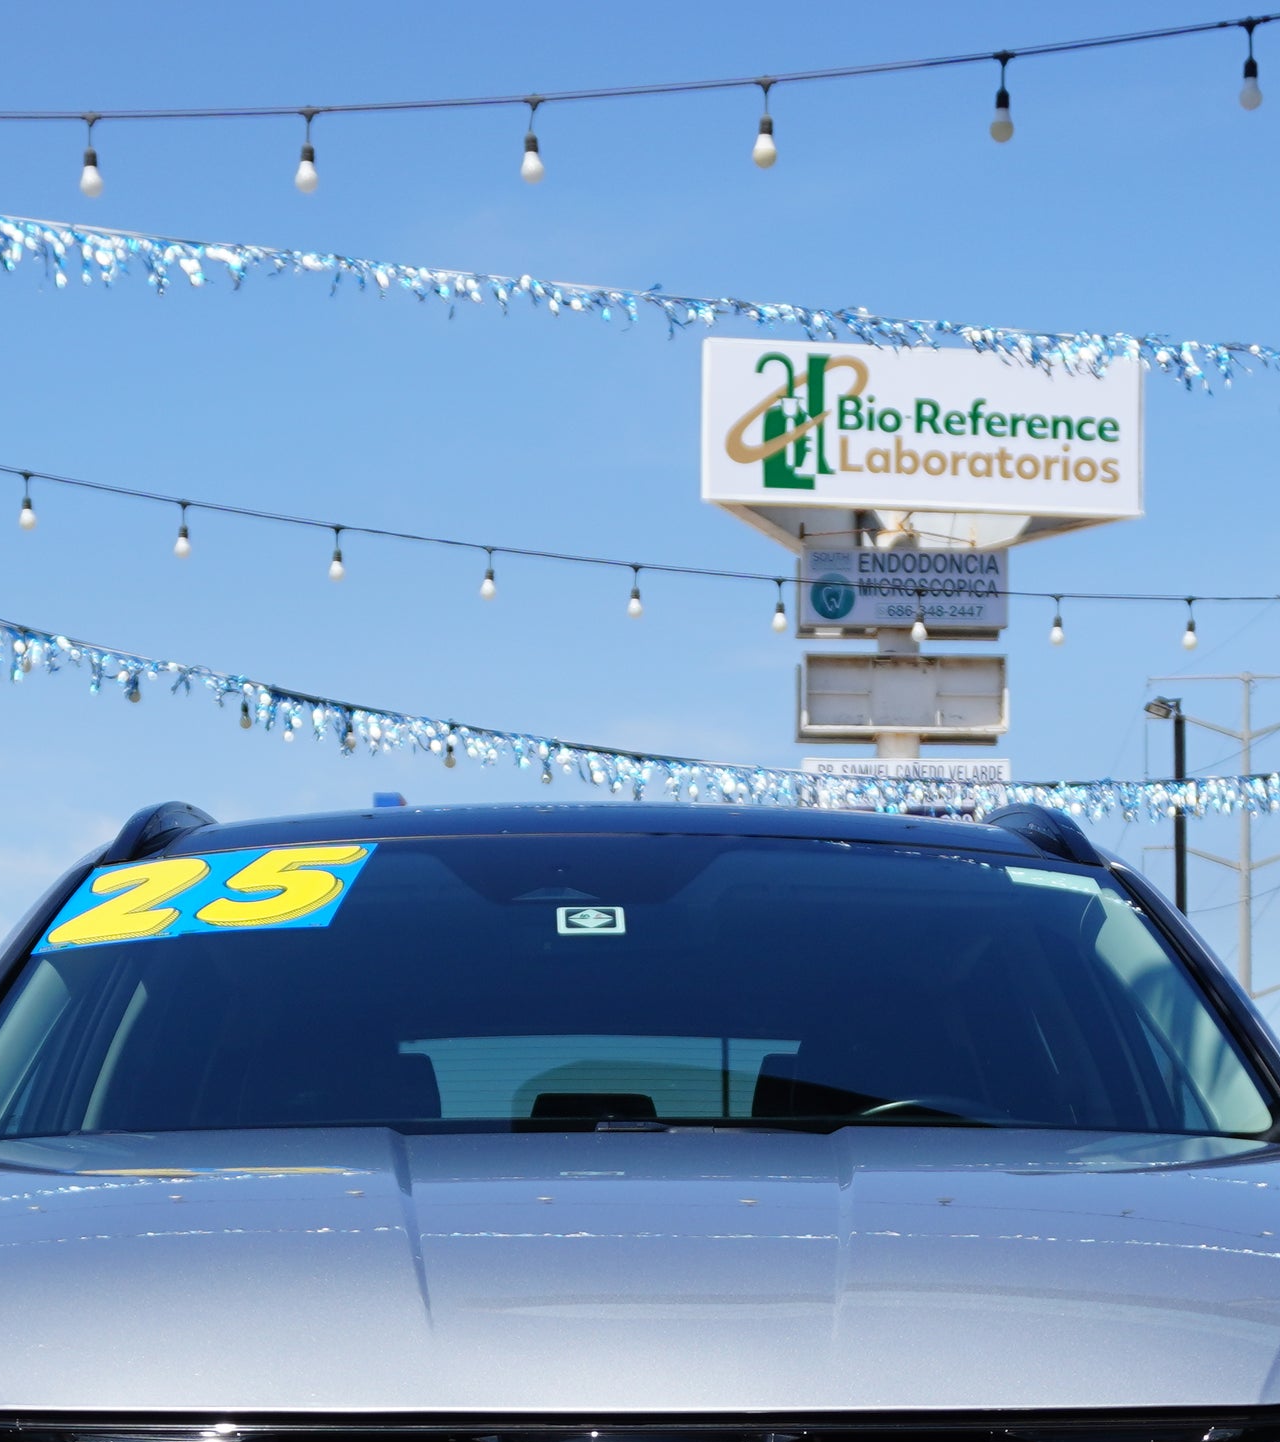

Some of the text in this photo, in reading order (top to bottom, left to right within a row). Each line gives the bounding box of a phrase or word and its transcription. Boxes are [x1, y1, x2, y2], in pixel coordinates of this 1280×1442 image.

[839, 434, 1120, 484] Laboratorios
[858, 553, 1000, 575] ENDODONCIA
[858, 577, 999, 599] MICROSCOPICA
[949, 765, 1004, 781] VELARDE
[47, 845, 368, 945] 25
